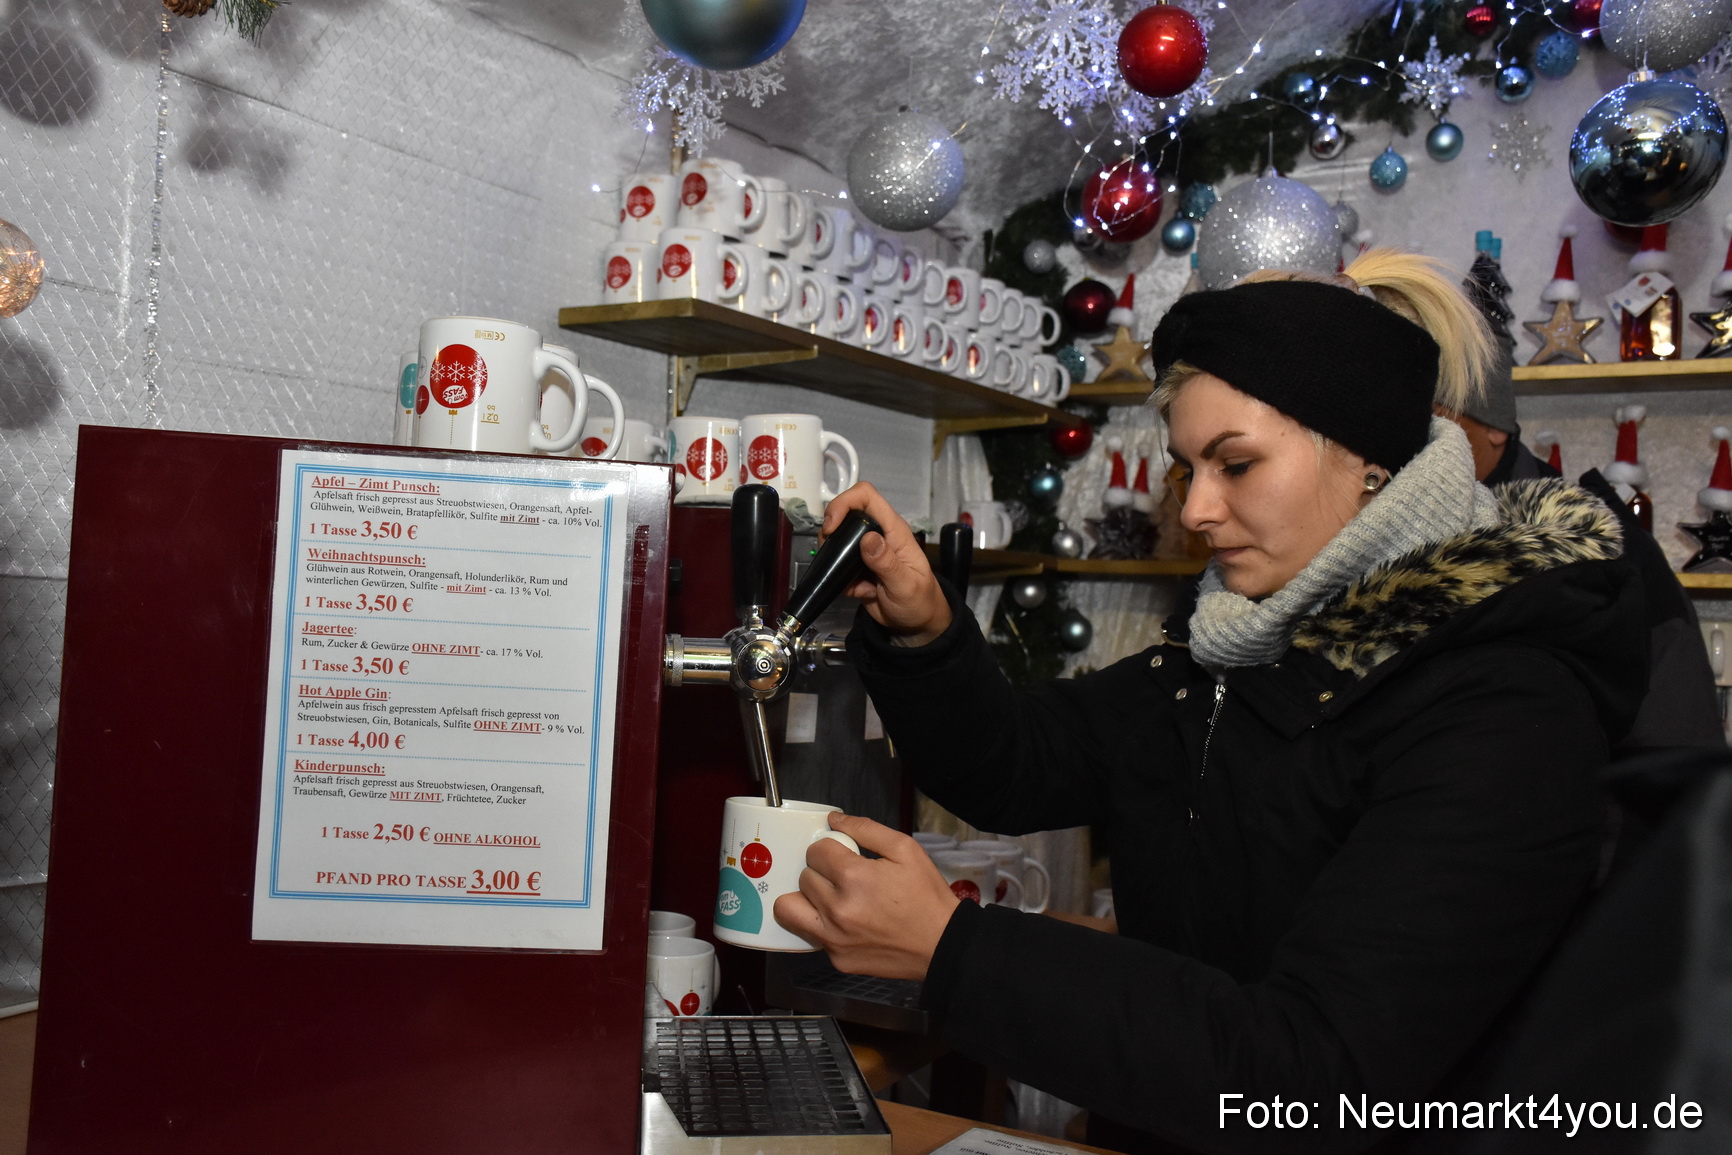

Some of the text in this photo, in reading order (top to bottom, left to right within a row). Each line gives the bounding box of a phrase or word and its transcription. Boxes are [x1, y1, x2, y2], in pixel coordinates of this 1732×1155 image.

[312, 476, 345, 489] Apfel
[359, 478, 389, 490] Zimt
[393, 480, 440, 493] Punsch:
[314, 491, 353, 501] Apfelsaft
[356, 493, 380, 502] frisch
[382, 494, 417, 505] gepresst
[437, 498, 507, 511] Streuobstwiesen,
[510, 502, 563, 514] Orangensaft,
[566, 506, 592, 516] Apfel-
[310, 503, 355, 513] Glühwein,
[358, 505, 403, 516] Weißwein,
[406, 506, 467, 520] Bratapfellikör,
[470, 512, 498, 521] Sulfite
[500, 514, 515, 523] mit
[518, 515, 540, 524] Zimt
[564, 518, 582, 526] 10%
[585, 519, 602, 527] Vol.
[310, 520, 418, 541] 1 Tasse 3,50 €
[307, 548, 426, 567] Weihnachtspunsch:
[307, 563, 348, 573] Glühwein
[368, 569, 406, 577] Rotwein,
[409, 569, 462, 580] Orangensaft,
[466, 573, 527, 584] Holunderlikör,
[530, 576, 549, 585] Rum
[552, 578, 568, 586] und
[306, 576, 359, 586] winterlichen
[362, 579, 407, 590] Gewürzen,
[410, 582, 438, 590] Sulfite
[447, 584, 462, 593] mit
[465, 584, 486, 594] Zimt
[511, 587, 520, 595] 13
[523, 588, 531, 596] %
[535, 588, 551, 597] Vol.
[305, 594, 414, 614] 1 Tasse 3,50 €
[302, 622, 357, 636] Jagertee:
[302, 638, 324, 647] Rum,
[327, 639, 357, 649] Zucker
[360, 641, 368, 649] &
[371, 641, 409, 651] Gewürze
[412, 643, 446, 654] OHNE
[486, 648, 498, 656] ca.
[502, 648, 511, 656] 17
[514, 649, 522, 657] %
[526, 650, 543, 658] Vol.
[301, 656, 410, 677] 1 Tasse 3,50 €
[299, 685, 391, 699] Hot Apple Gin:
[298, 700, 343, 710] Apfelwein
[363, 703, 386, 712] frisch
[389, 705, 436, 714] gepresstem
[439, 707, 478, 717] Apfelsaft
[481, 708, 504, 717] frisch
[507, 710, 541, 720] gepresst
[297, 713, 369, 724] Streuobstwiesen,
[372, 716, 390, 726] Gin,
[394, 717, 440, 728] Botanicals,
[444, 720, 471, 729] Sulfite
[474, 720, 508, 731] OHNE
[548, 725, 552, 733] 9
[556, 725, 564, 733] %
[567, 726, 584, 734] Vol.
[297, 731, 406, 751] 1 Tasse 4,00 €
[295, 759, 385, 774] Kinderpunsch:
[294, 775, 333, 785] Apfelsaft
[336, 776, 359, 786] frisch
[362, 778, 397, 788] gepresst
[417, 780, 488, 792] Streuobstwiesen,
[491, 783, 544, 794] Orangensaft,
[293, 787, 346, 798] Traubensaft,
[349, 789, 387, 799] Gewürze
[390, 791, 411, 800] MIT
[447, 793, 494, 804] Früchtetee,
[496, 795, 526, 805] Zucker
[321, 823, 541, 847] 1 Tasse 2,50 € OHNE ALKOHOL
[316, 869, 542, 893] PFAND PRO TASSE 3,00 €
[720, 900, 741, 911] FASS
